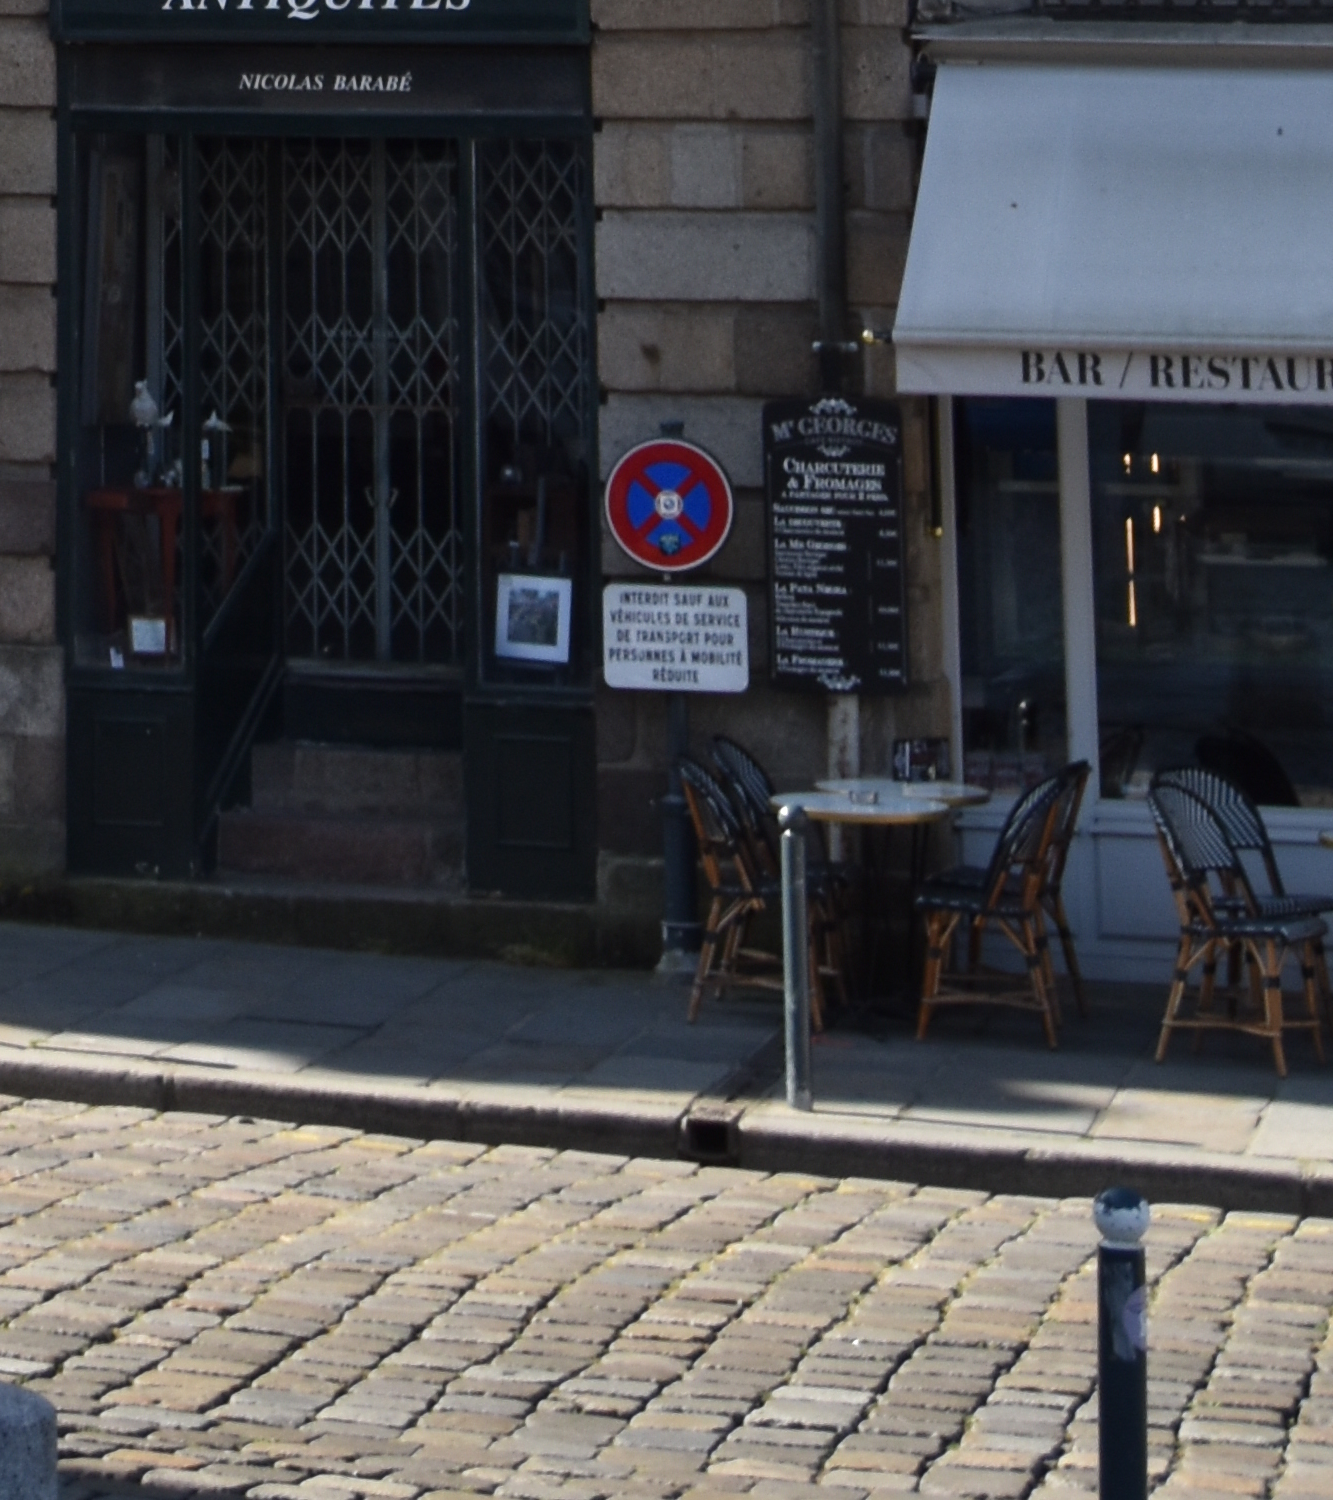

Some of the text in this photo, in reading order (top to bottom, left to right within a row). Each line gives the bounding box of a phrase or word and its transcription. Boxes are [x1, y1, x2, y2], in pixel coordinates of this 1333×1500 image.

[238, 71, 413, 92] NICOLAS BARABÉ
[1020, 350, 1104, 386] BAR
[797, 417, 898, 444] GEORGES
[619, 591, 729, 607] INTERDIT SAUF AUX
[610, 608, 741, 628] VÉHICULES DE SERVICE
[616, 629, 734, 645] DE TRANSPORT POUR
[608, 648, 675, 663] PERSONNES
[691, 650, 742, 666] MOBILITÉ
[652, 667, 699, 684] RÉDUITE
